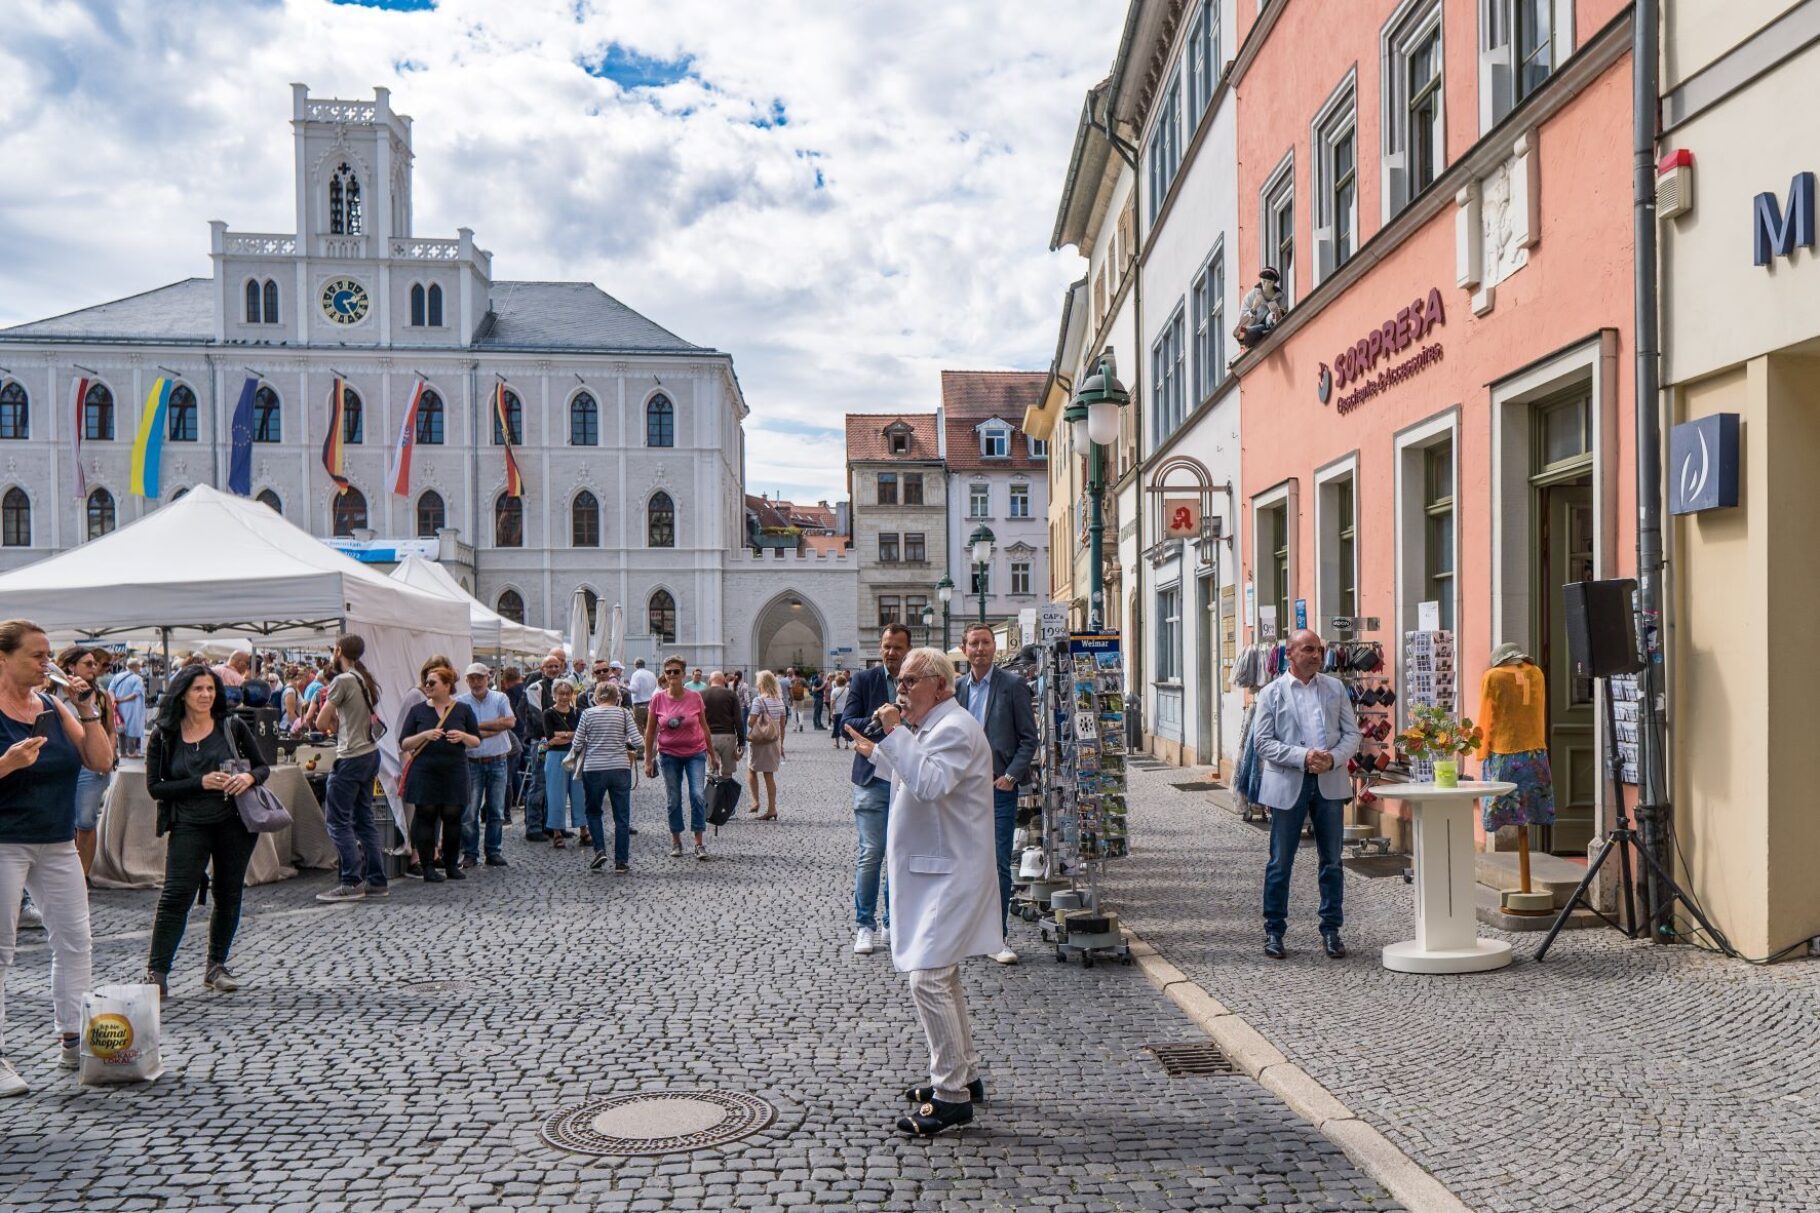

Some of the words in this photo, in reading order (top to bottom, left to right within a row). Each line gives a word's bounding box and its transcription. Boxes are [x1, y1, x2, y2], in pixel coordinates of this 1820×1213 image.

[1753, 171, 1816, 266] M
[1334, 287, 1445, 389] SORPRESA
[1081, 640, 1109, 648] Weimar
[91, 1038, 128, 1049] Shopper
